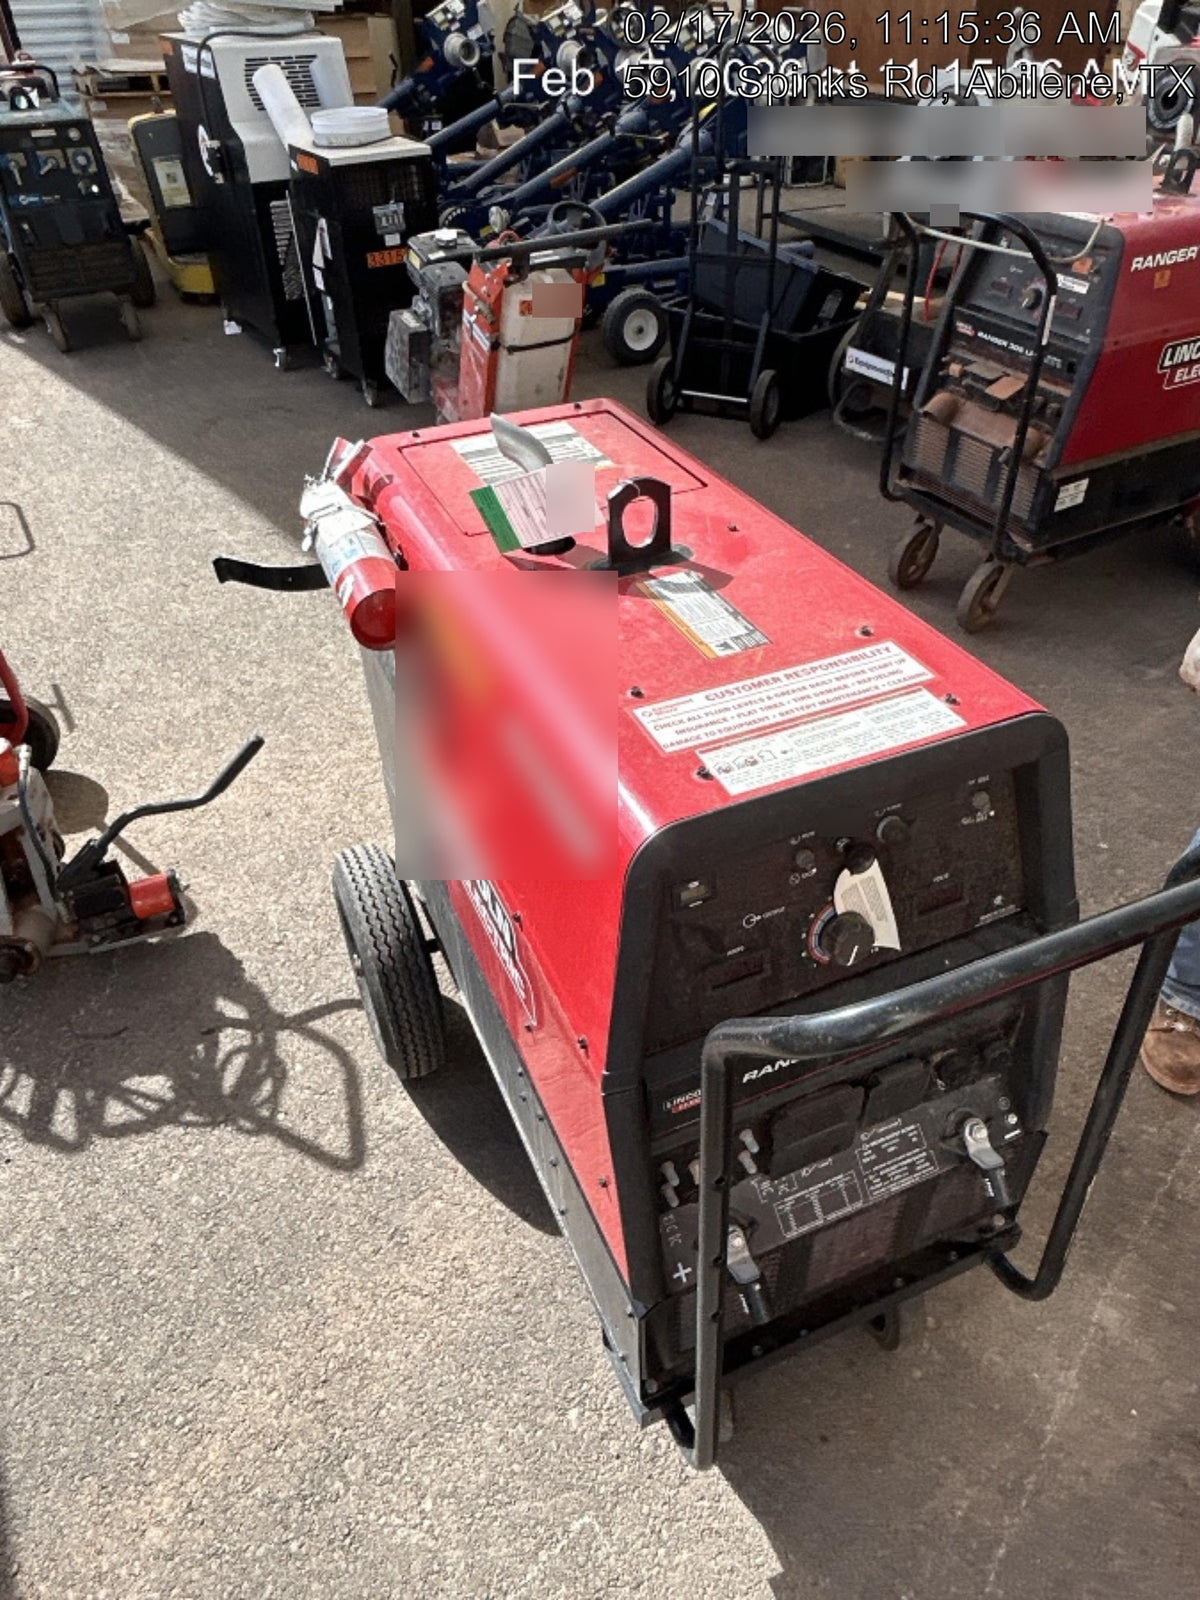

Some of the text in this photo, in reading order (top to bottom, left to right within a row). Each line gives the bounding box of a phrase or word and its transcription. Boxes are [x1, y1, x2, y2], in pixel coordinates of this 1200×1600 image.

[1130, 245, 1199, 273] RANGER
[705, 646, 891, 701] CUSTOMER RESPONSIBILITY
[653, 719, 686, 731] CHECK
[687, 714, 702, 722] ALL
[732, 697, 765, 710] LEVELS
[808, 679, 833, 689] DAILY
[834, 669, 867, 681] BEFORE
[868, 662, 893, 672] START
[736, 709, 758, 718] FLAT
[742, 1058, 799, 1084] RAN
